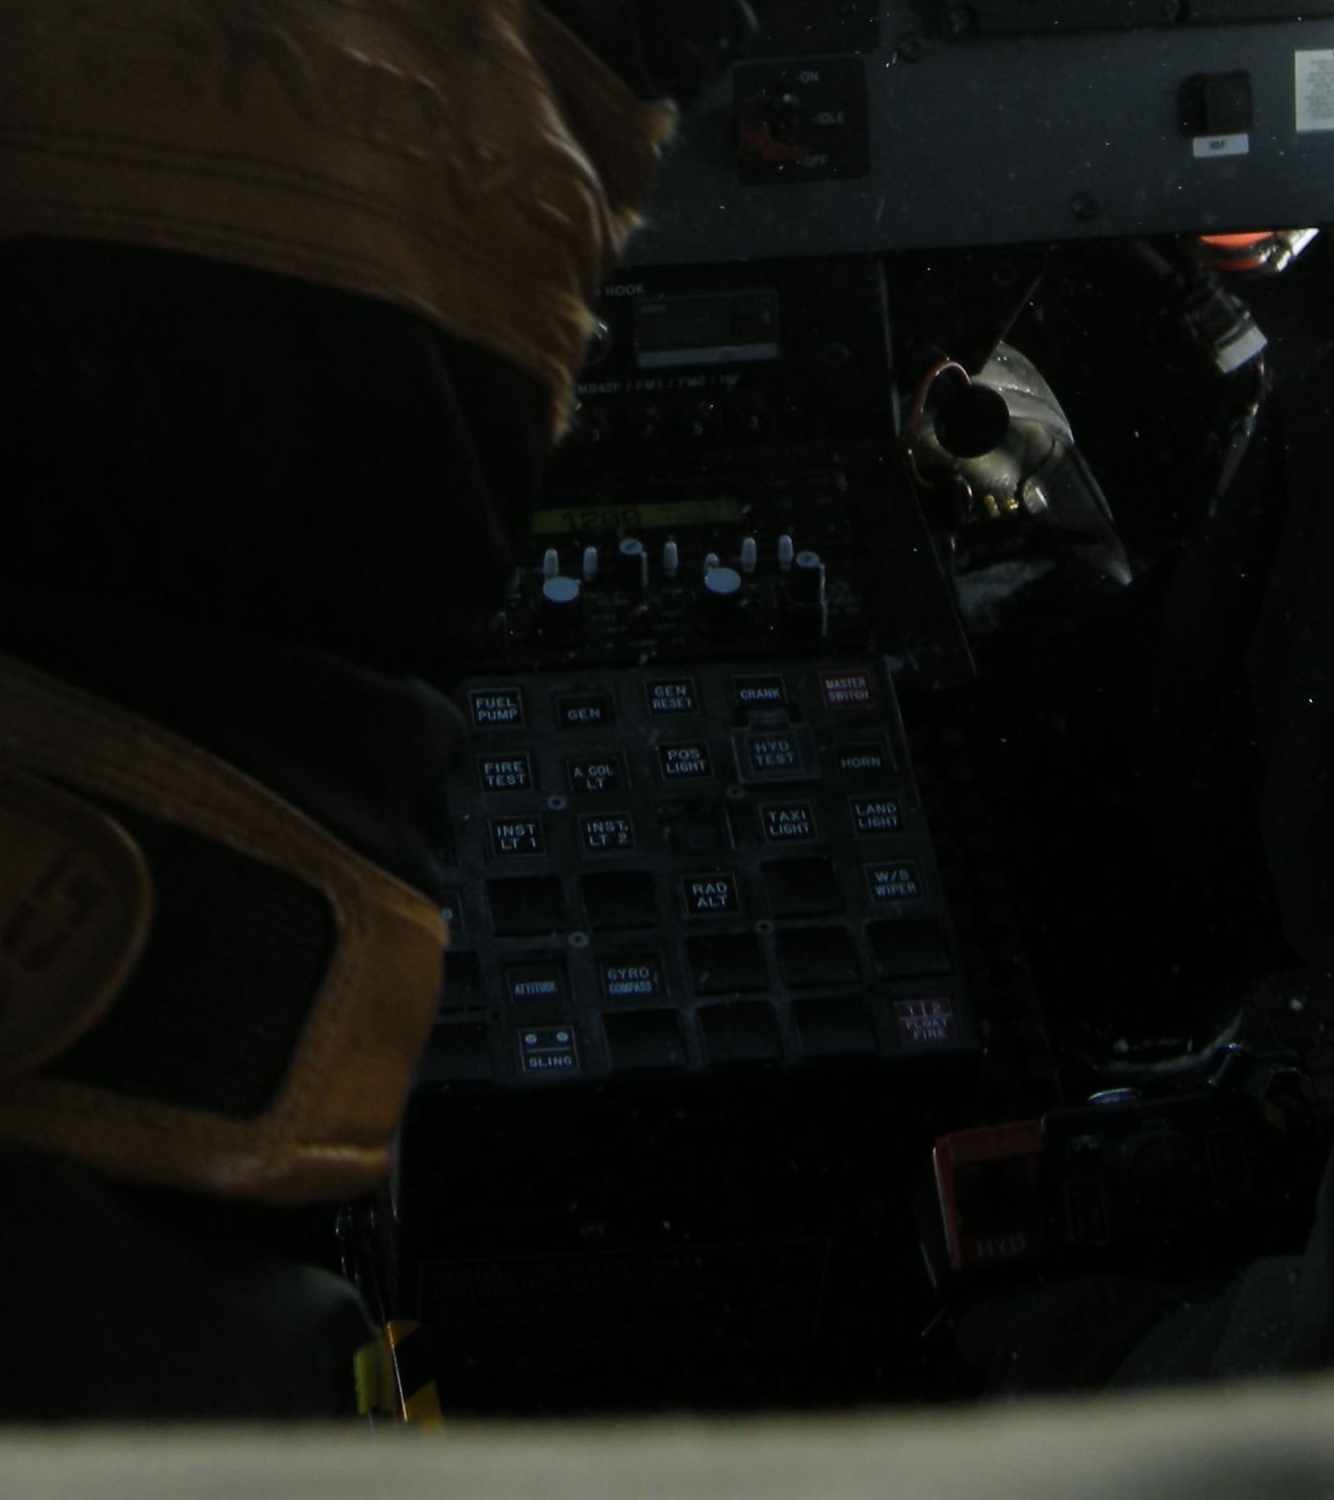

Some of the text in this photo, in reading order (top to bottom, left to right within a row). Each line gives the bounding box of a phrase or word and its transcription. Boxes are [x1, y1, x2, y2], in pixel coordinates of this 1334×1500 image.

[605, 283, 645, 298] HOOK
[561, 508, 642, 531] 1200
[825, 677, 867, 690] MASTER
[654, 685, 687, 698] GEN
[740, 688, 781, 701] CRANK
[828, 690, 869, 703] SWITCH
[476, 697, 515, 709] FUEL
[653, 697, 692, 710] RESET
[477, 709, 518, 722] PUMP
[567, 708, 601, 721] GEN
[755, 739, 790, 753] HYD
[667, 749, 700, 761] POS
[756, 752, 795, 766] TEST
[840, 755, 882, 769] HORN
[483, 761, 524, 775] FIRE
[588, 764, 614, 777] COL
[666, 760, 706, 775] LIGHT
[486, 774, 526, 787] TEST
[586, 777, 605, 790] LT
[768, 809, 806, 823] TAXI
[855, 802, 897, 817] LAND
[769, 822, 810, 837] LIGHT
[857, 815, 899, 830] LIGHT
[496, 823, 536, 837] INST
[500, 838, 519, 851] LT
[589, 834, 608, 848] LT
[875, 869, 910, 882] W/S
[692, 882, 728, 895] RAD
[874, 881, 917, 897] WIPER
[697, 895, 728, 909] ALT
[607, 966, 650, 981] GYRO
[609, 980, 652, 996] COMPASS
[905, 1017, 947, 1030] FLOAT
[914, 1027, 945, 1040] FIRE
[528, 1055, 573, 1069] SLING
[977, 1233, 1027, 1257] HYD
